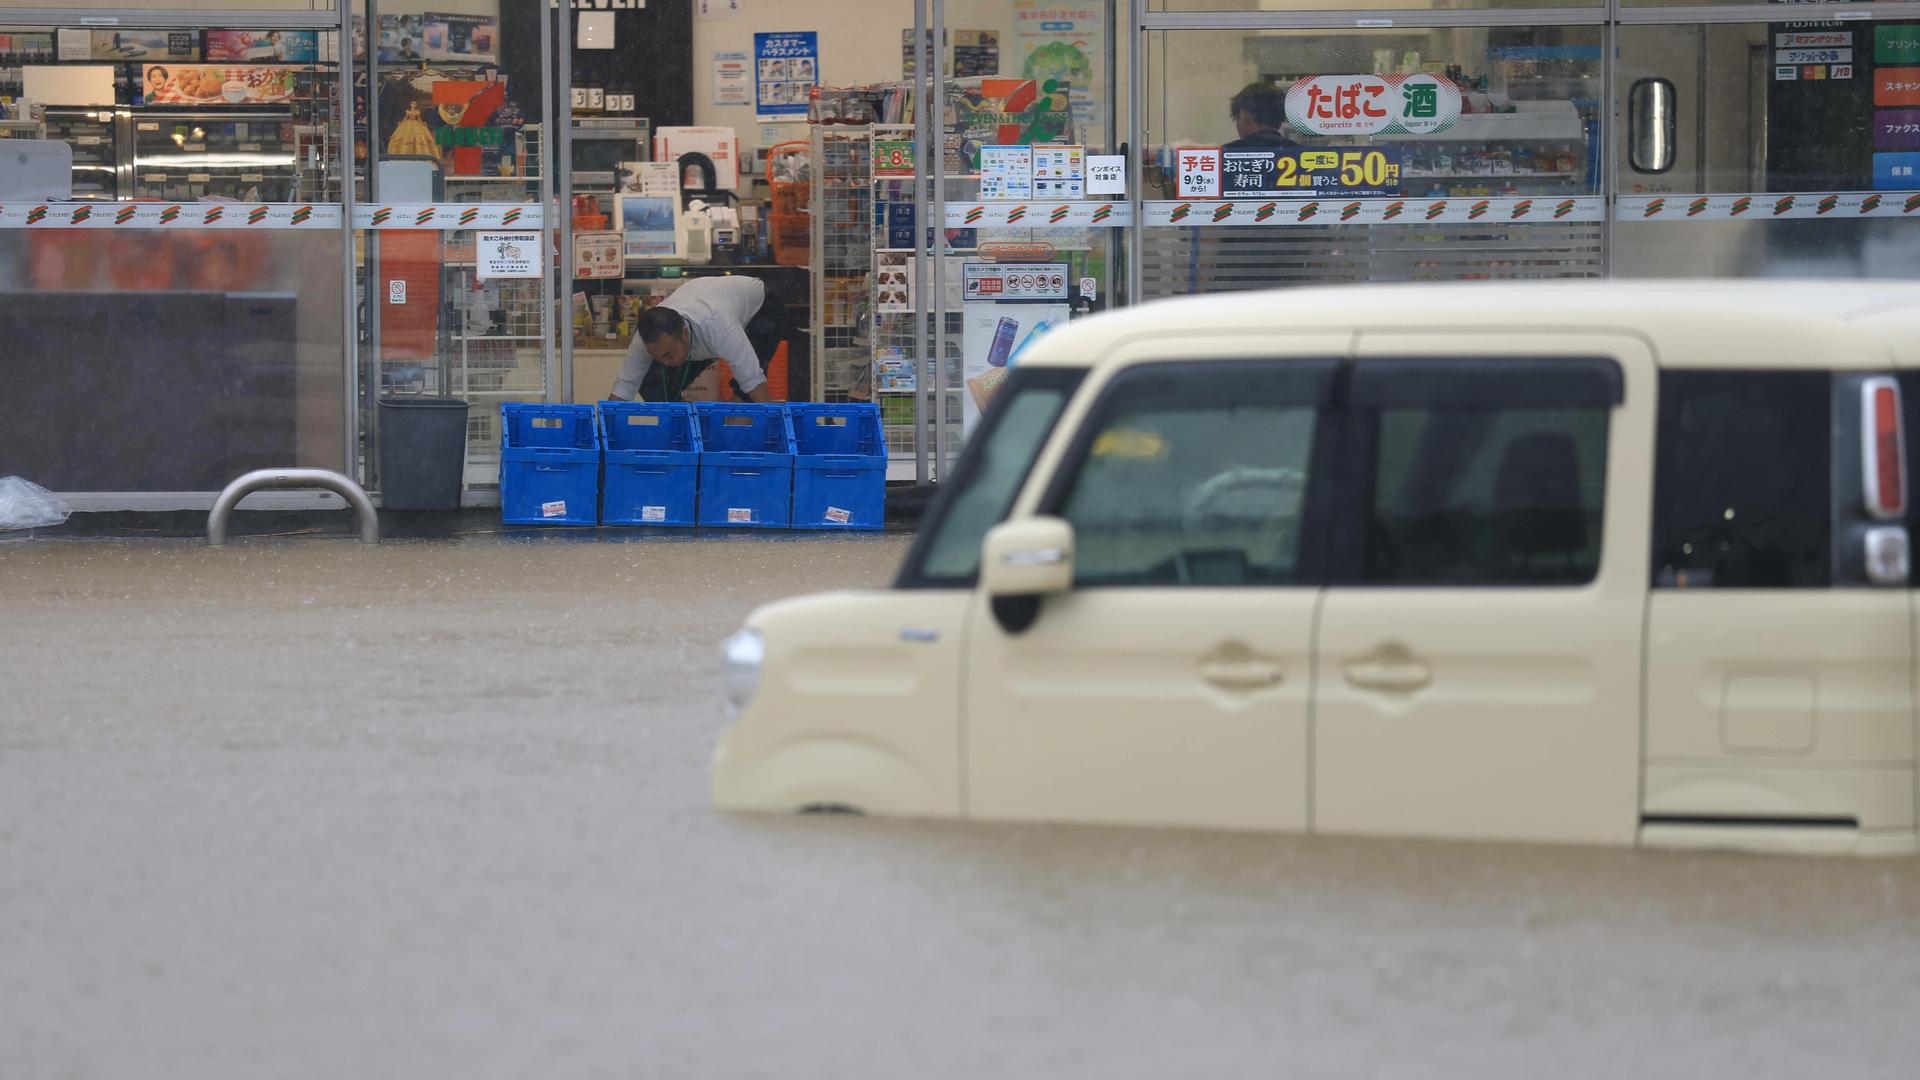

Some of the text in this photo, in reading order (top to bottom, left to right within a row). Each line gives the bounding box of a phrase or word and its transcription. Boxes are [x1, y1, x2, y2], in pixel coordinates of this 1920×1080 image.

[765, 39, 807, 48] カスタマー
[762, 47, 811, 57] ハラスメント
[1886, 82, 1920, 91] スキャン
[1307, 82, 1438, 119] たばこ 酒
[1319, 121, 1353, 129] cigarette
[1885, 124, 1920, 133] ファクス
[1182, 156, 1216, 172] 予告
[1223, 159, 1275, 172] おにぎり
[1304, 156, 1334, 166] 一度に
[1892, 166, 1913, 176] 保険
[1234, 173, 1263, 187] 寿司
